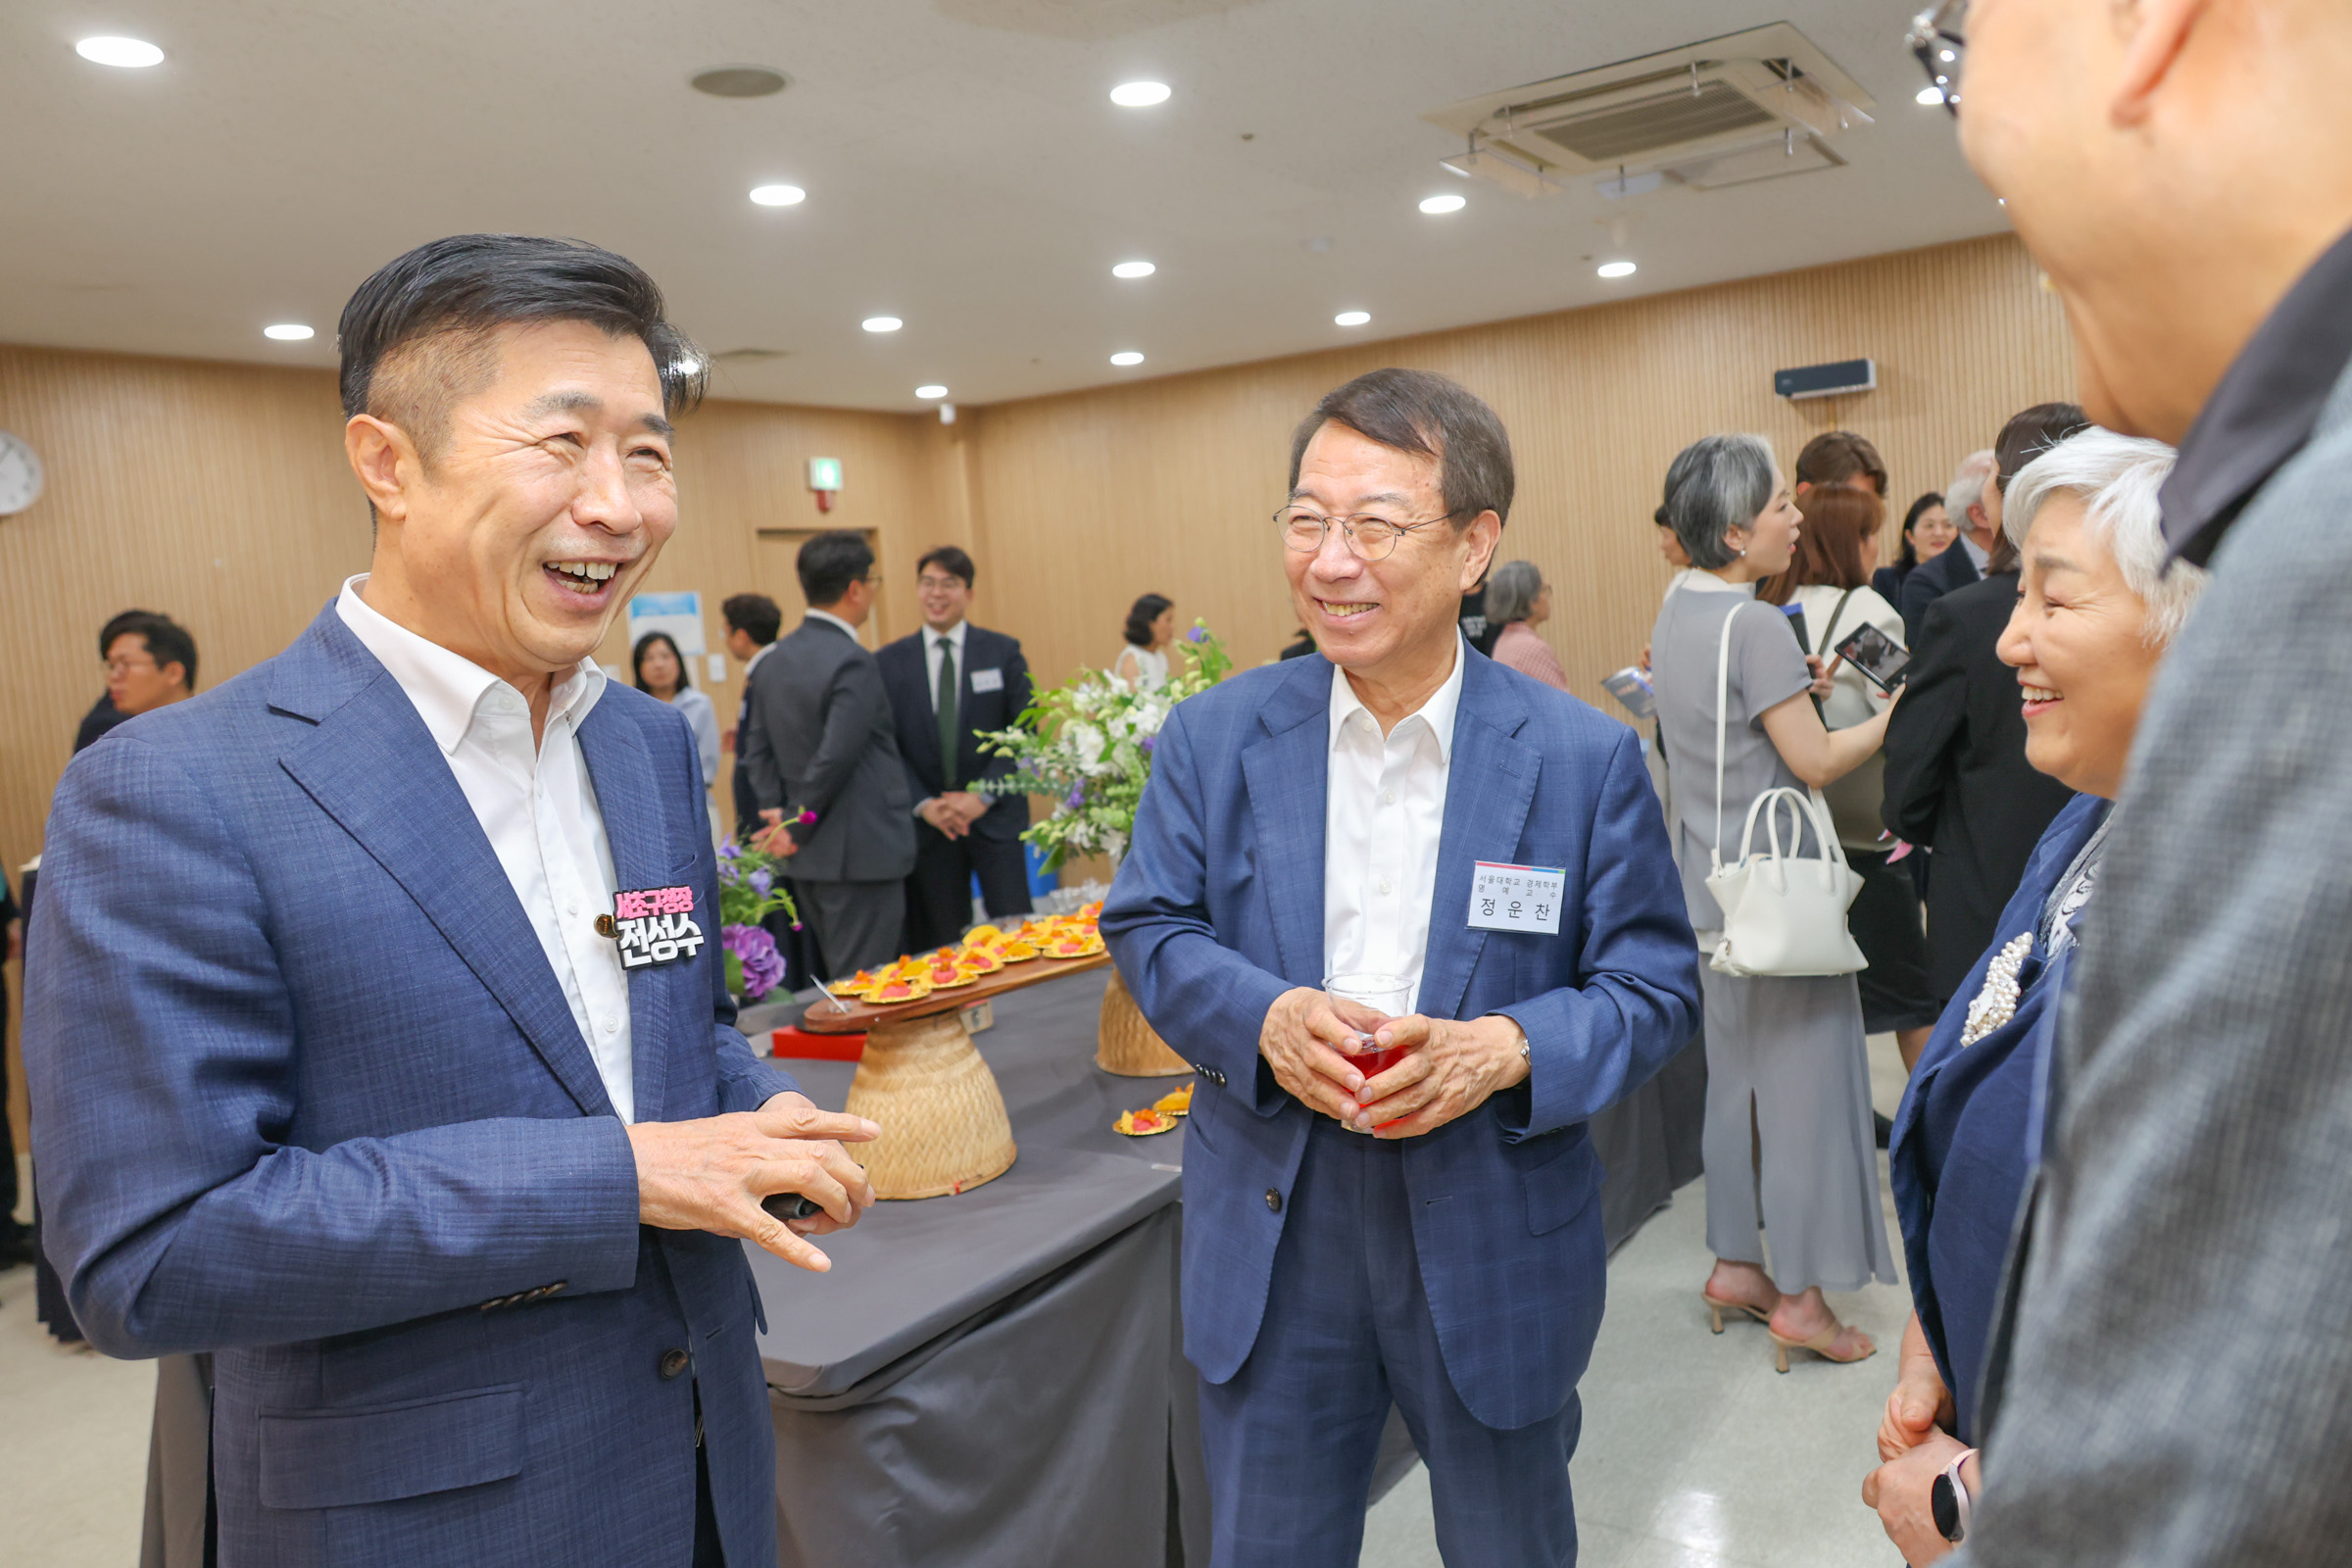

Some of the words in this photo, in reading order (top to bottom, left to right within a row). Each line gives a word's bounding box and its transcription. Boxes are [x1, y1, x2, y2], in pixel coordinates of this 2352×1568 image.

[1479, 875, 1520, 886] 서울대학교
[1526, 879, 1557, 890] 경제학부
[615, 886, 694, 919] 서초구청장
[617, 912, 705, 967] 전성수
